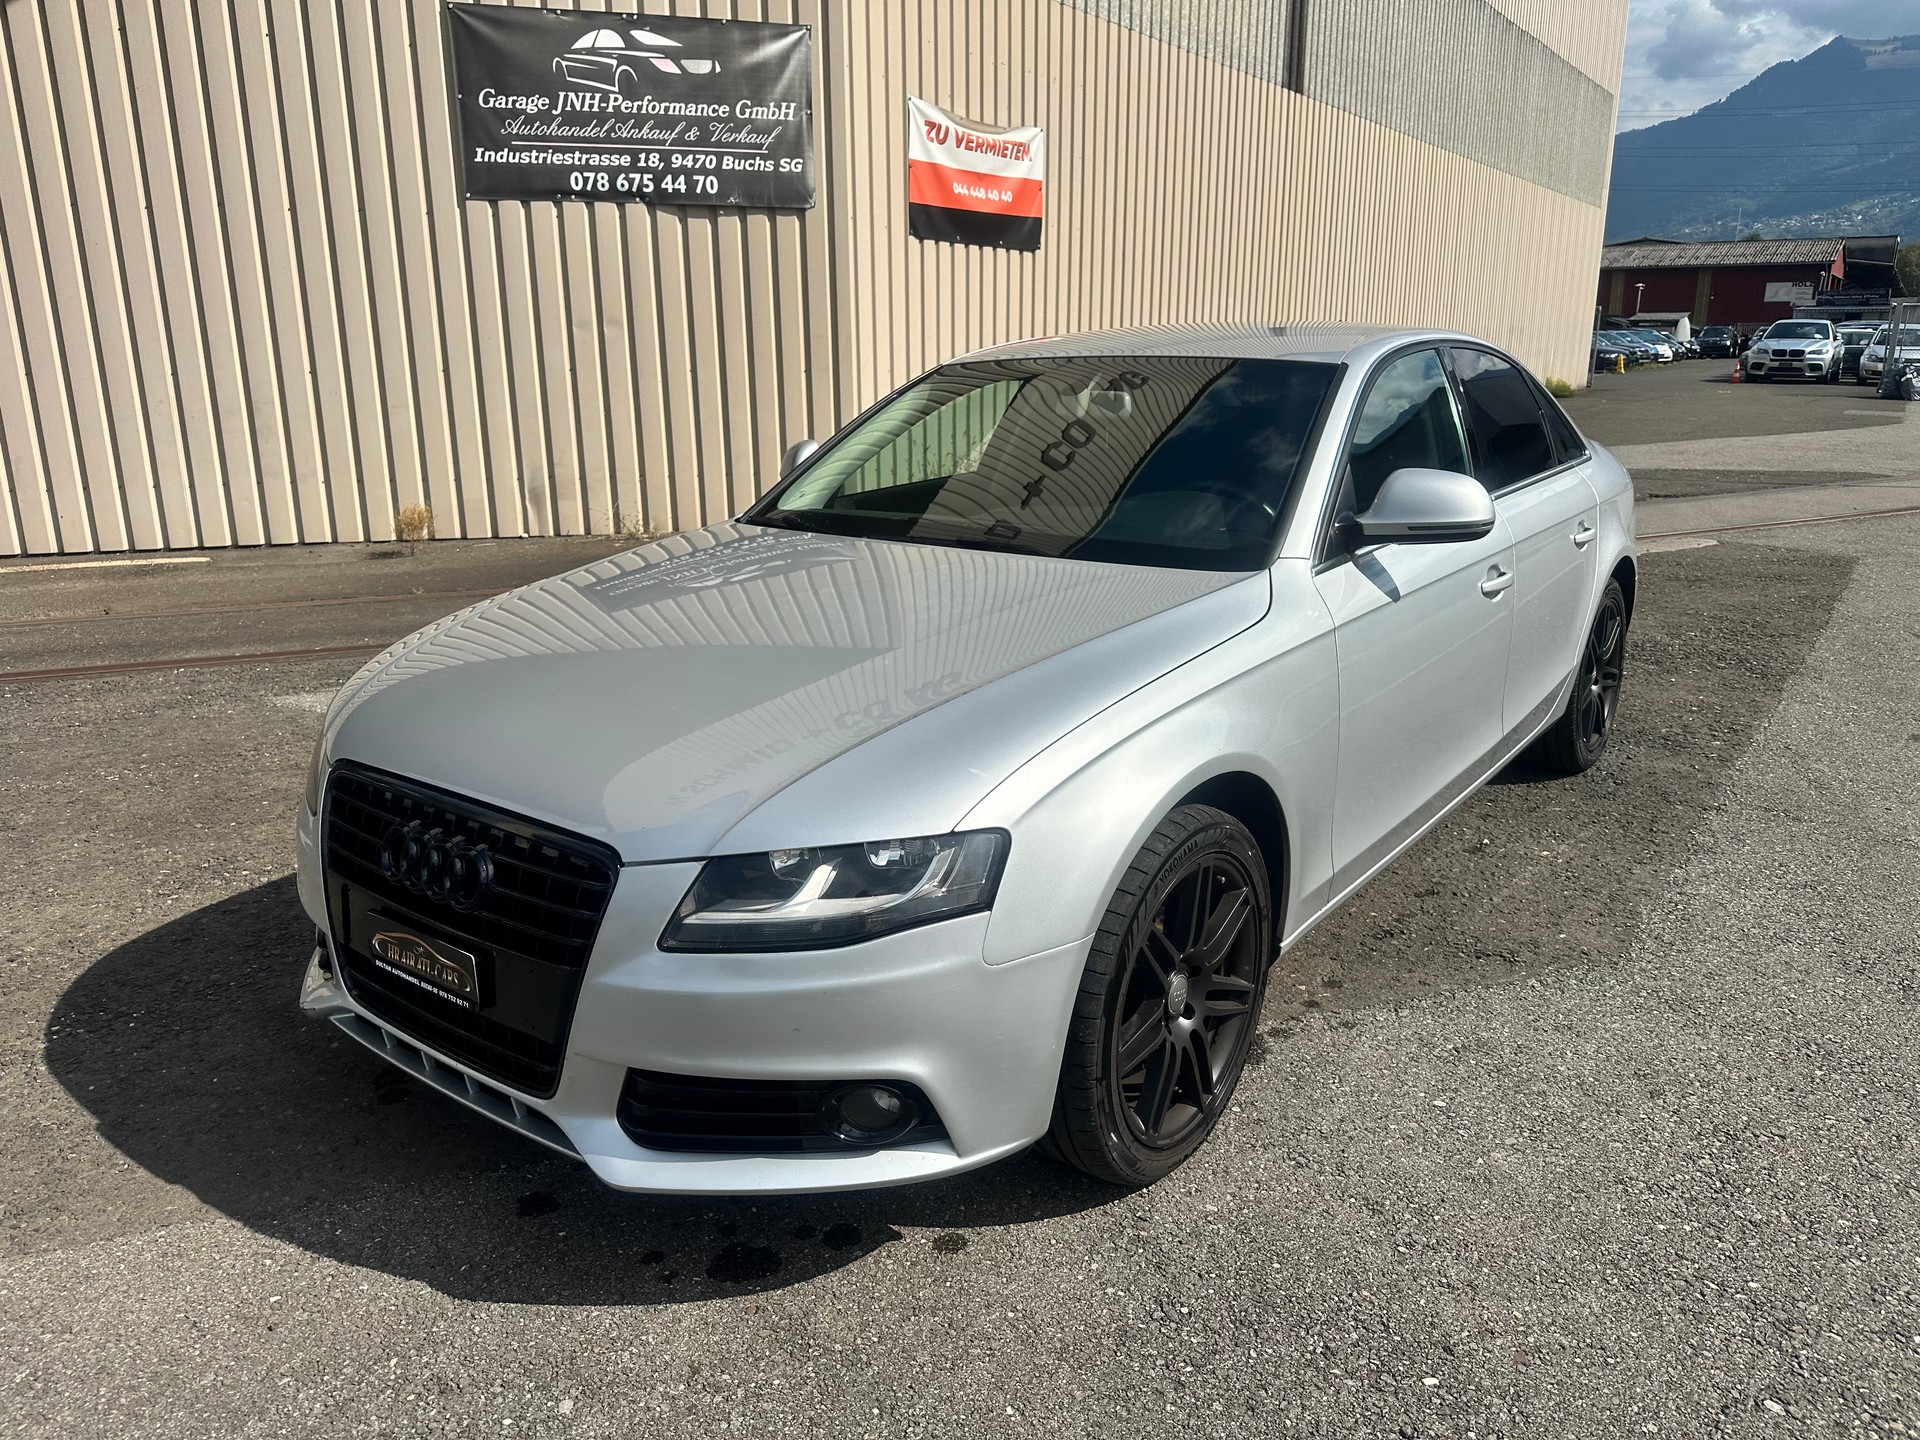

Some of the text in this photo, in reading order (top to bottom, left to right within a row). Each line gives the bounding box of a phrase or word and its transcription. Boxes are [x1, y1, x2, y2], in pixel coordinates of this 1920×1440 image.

[478, 88, 797, 121] Garage JNH-Performance GmbH
[500, 115, 783, 150] Autohandel Ankauf & Verkauf
[924, 120, 1033, 162] ZU VERMIETEN
[473, 147, 804, 173] Industriestrasse 18, 9470 Buchs SG
[570, 171, 719, 195] 078 675 44 70
[953, 182, 1013, 203] 044 448 40 40
[1160, 840, 1198, 883] YOKOHAMA
